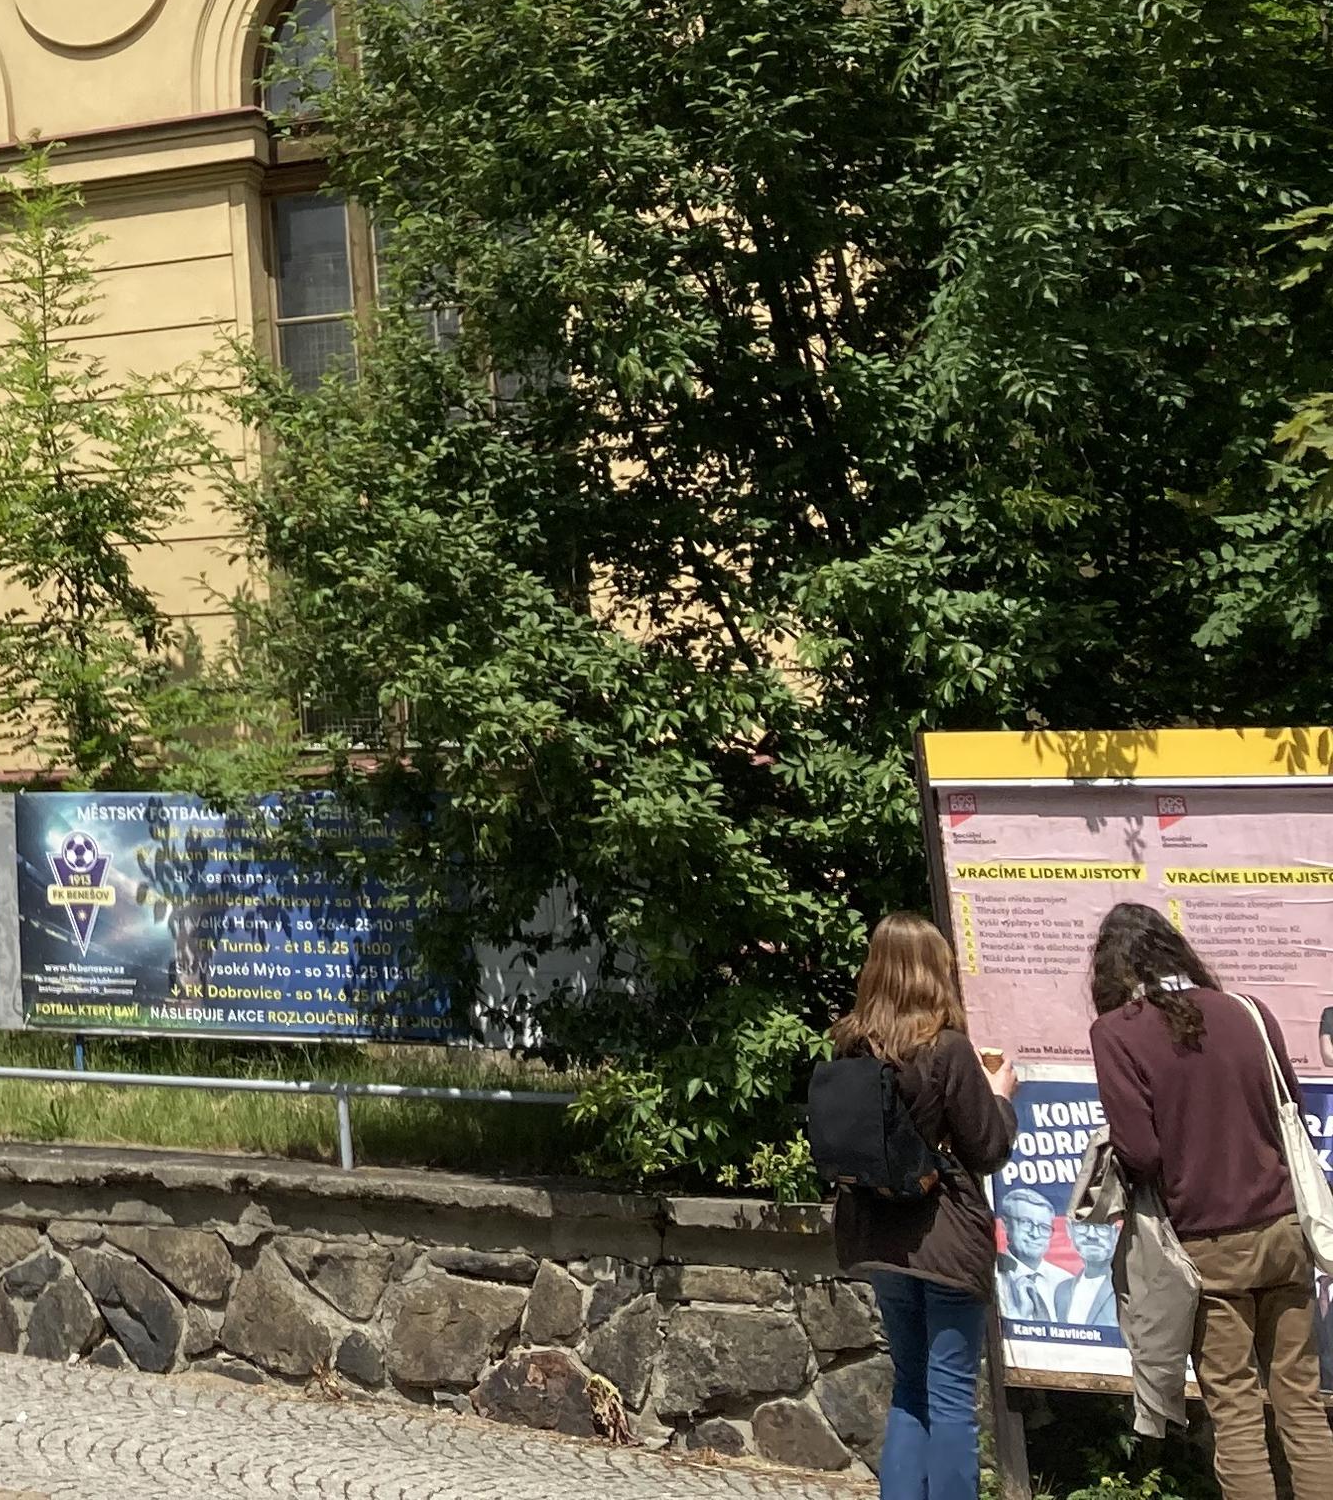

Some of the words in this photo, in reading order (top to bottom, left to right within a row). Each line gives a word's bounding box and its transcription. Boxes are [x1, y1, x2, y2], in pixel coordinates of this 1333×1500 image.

[77, 803, 146, 821] MĚSTSKÝ
[198, 869, 279, 886] Kosmonosy
[957, 864, 1027, 879] VRACÍME
[1030, 868, 1077, 879] LIDEM
[1079, 867, 1142, 880] JISTOTY
[1166, 868, 1240, 883] VRACÍME
[1244, 872, 1294, 883] LIDEM
[69, 875, 91, 886] 1913
[53, 889, 64, 899] FK
[67, 888, 109, 900] BENEŠOV
[234, 915, 282, 932] Hamry
[297, 920, 314, 932] so
[1041, 919, 1052, 927] 10
[1256, 925, 1267, 933] 10
[220, 939, 271, 953] Turnov
[285, 940, 299, 954] čt
[303, 941, 350, 955] 8.5.25
[199, 961, 250, 977] Vysoké
[253, 962, 291, 979] Mýto
[305, 967, 322, 978] so
[326, 964, 379, 979] 31.5.25
[185, 984, 203, 998] FK
[208, 984, 282, 999] Dobrovice
[296, 989, 313, 1000] so
[36, 1003, 76, 1015] FOTBAL
[79, 1003, 112, 1016] KTERÝ
[115, 1002, 139, 1017] BAVÍ
[150, 1004, 224, 1021] NÁSLEDUJE
[228, 1009, 264, 1023] AKCE
[268, 1010, 359, 1026] ROZLOUČENÍ
[1018, 1045, 1041, 1054] Jana
[1044, 1045, 1090, 1055] Maláčová
[1032, 1101, 1107, 1128] KONE
[1013, 1130, 1099, 1156] ODRA
[1013, 1323, 1046, 1337] Karel
[1050, 1327, 1102, 1341] Havlíček
